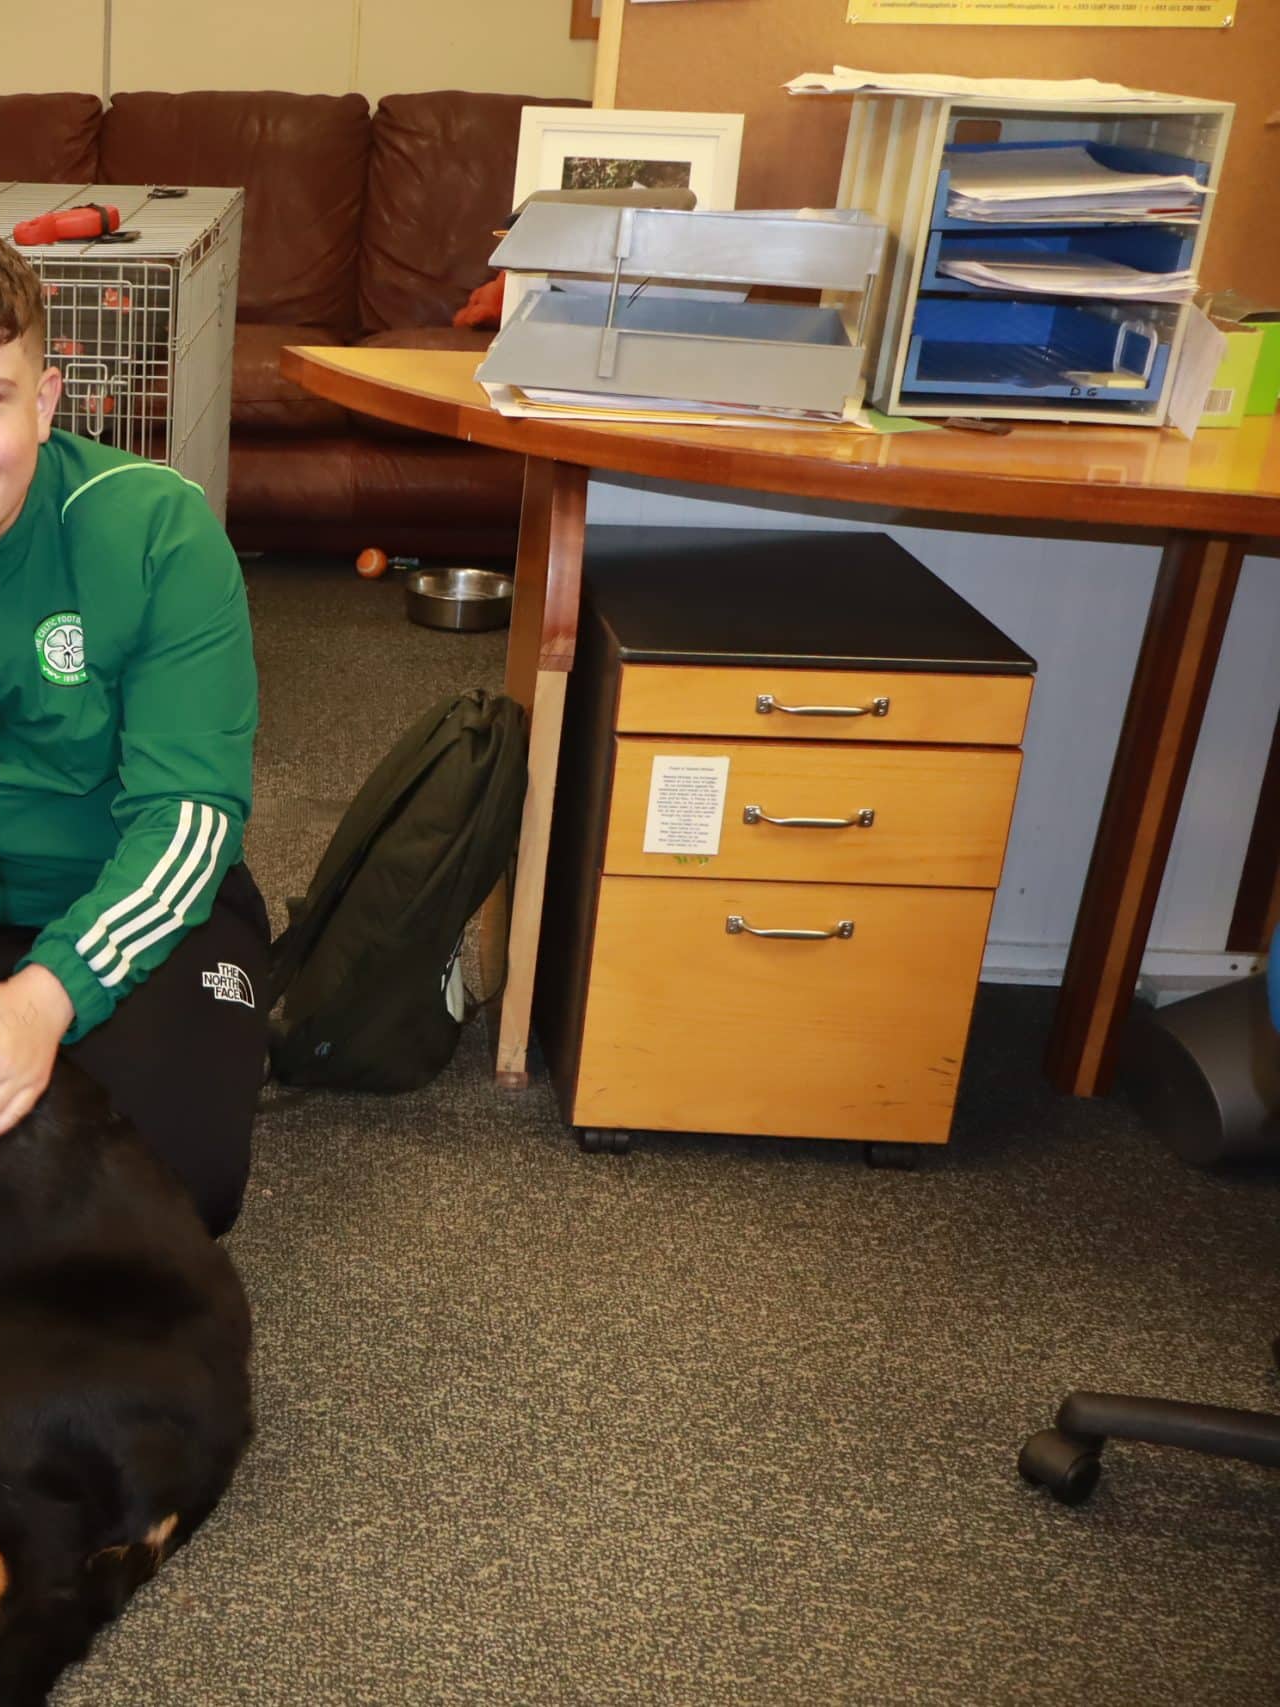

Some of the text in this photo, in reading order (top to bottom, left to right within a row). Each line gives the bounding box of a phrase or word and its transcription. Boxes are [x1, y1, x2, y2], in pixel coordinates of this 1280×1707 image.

[57, 615, 81, 624] FOOTB
[221, 965, 239, 978] THE
[204, 974, 239, 989] NORTH
[216, 987, 240, 999] FACE
